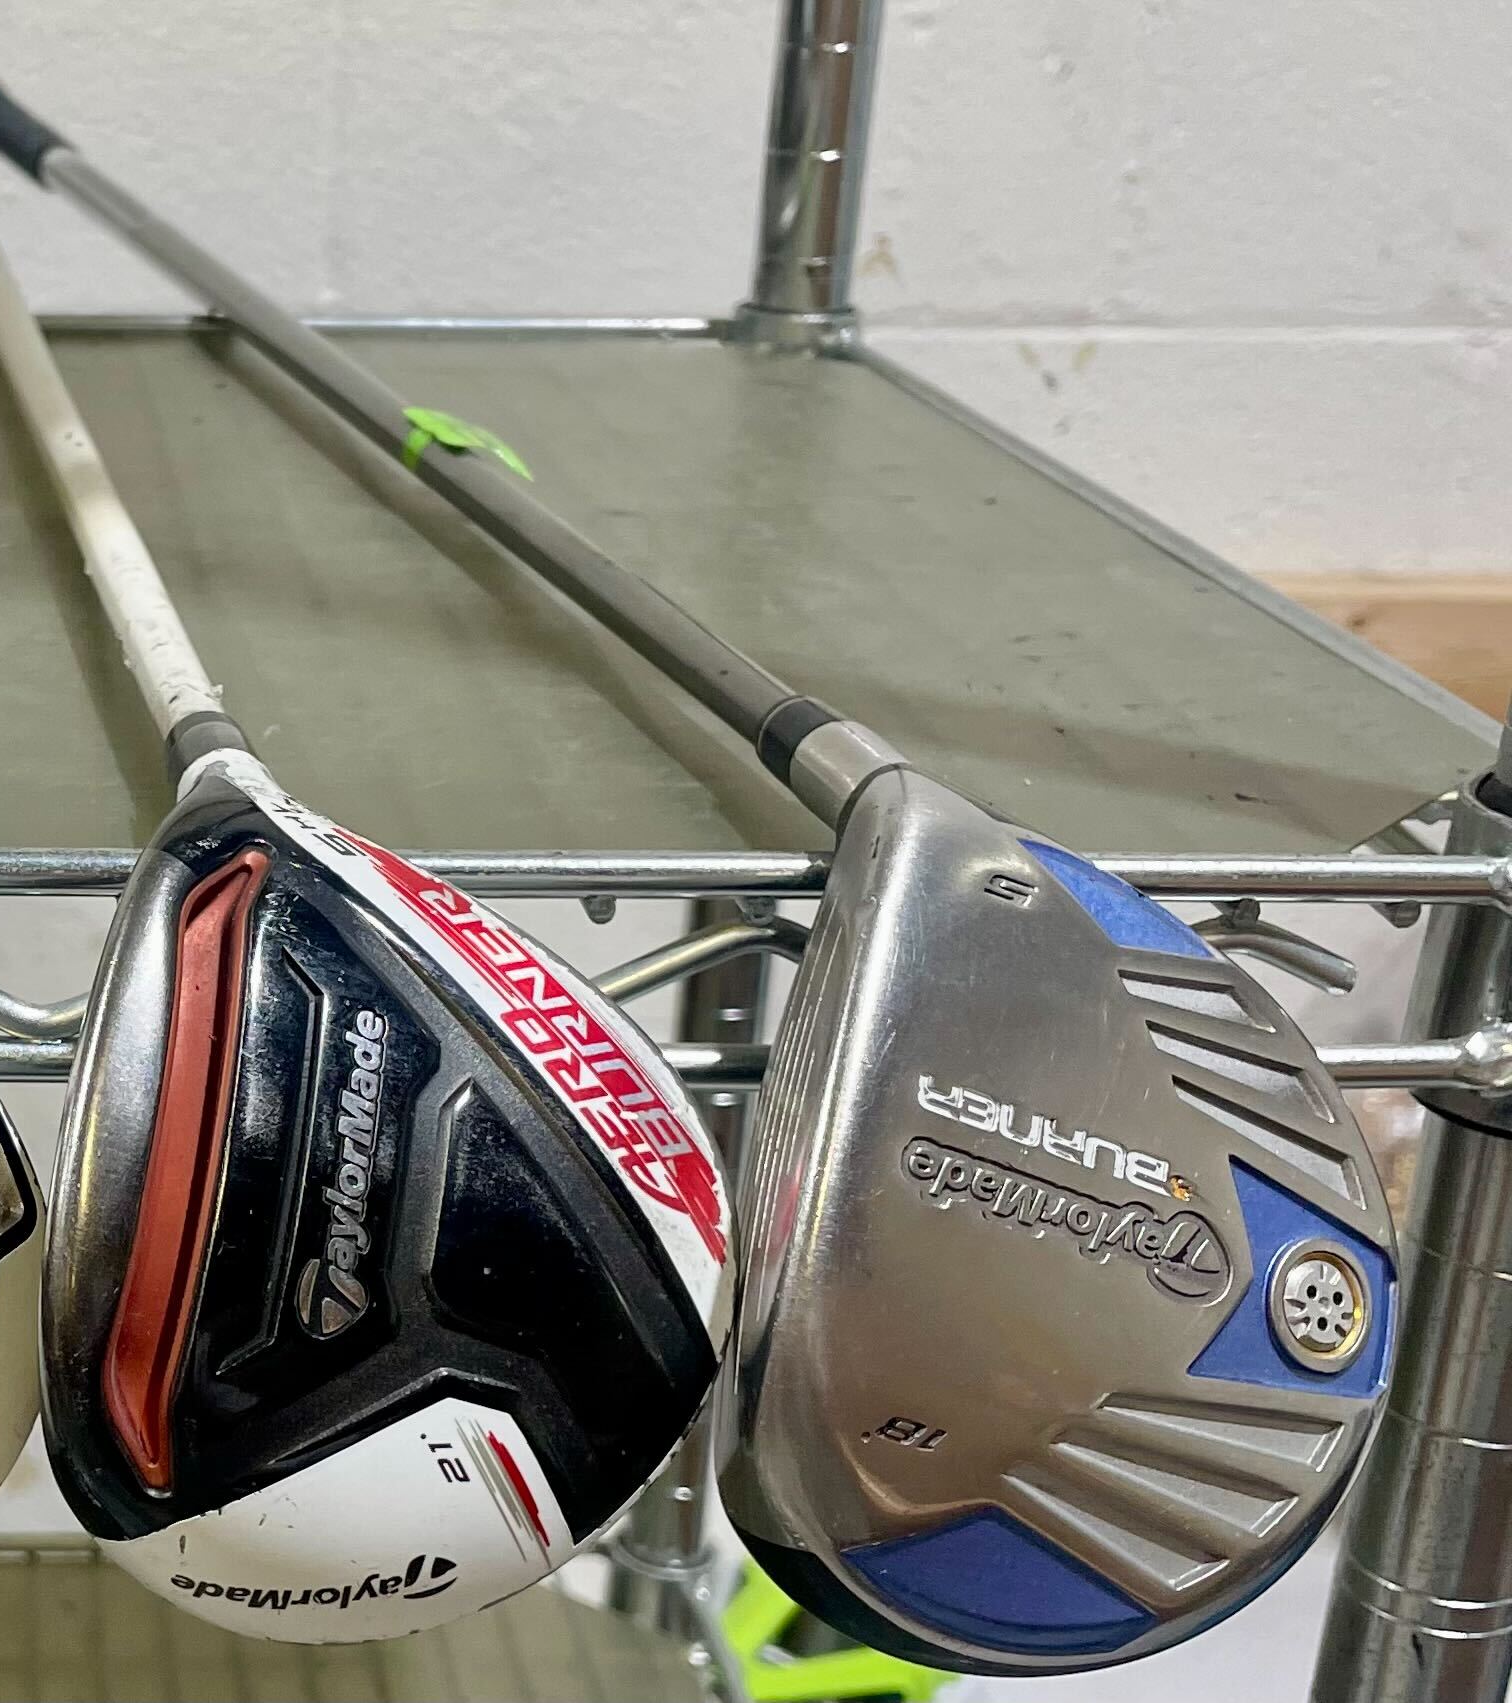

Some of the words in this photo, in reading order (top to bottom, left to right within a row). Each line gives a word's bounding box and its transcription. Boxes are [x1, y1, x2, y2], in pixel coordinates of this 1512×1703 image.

[984, 874, 1039, 908] 5
[418, 887, 693, 1158] BURNER
[298, 1009, 384, 1336] TaylorMade
[500, 1009, 689, 1214] AERO
[917, 1074, 1172, 1198] BURNER
[905, 1141, 1228, 1300] TaylorMade
[170, 1554, 458, 1609] TaylorMade
